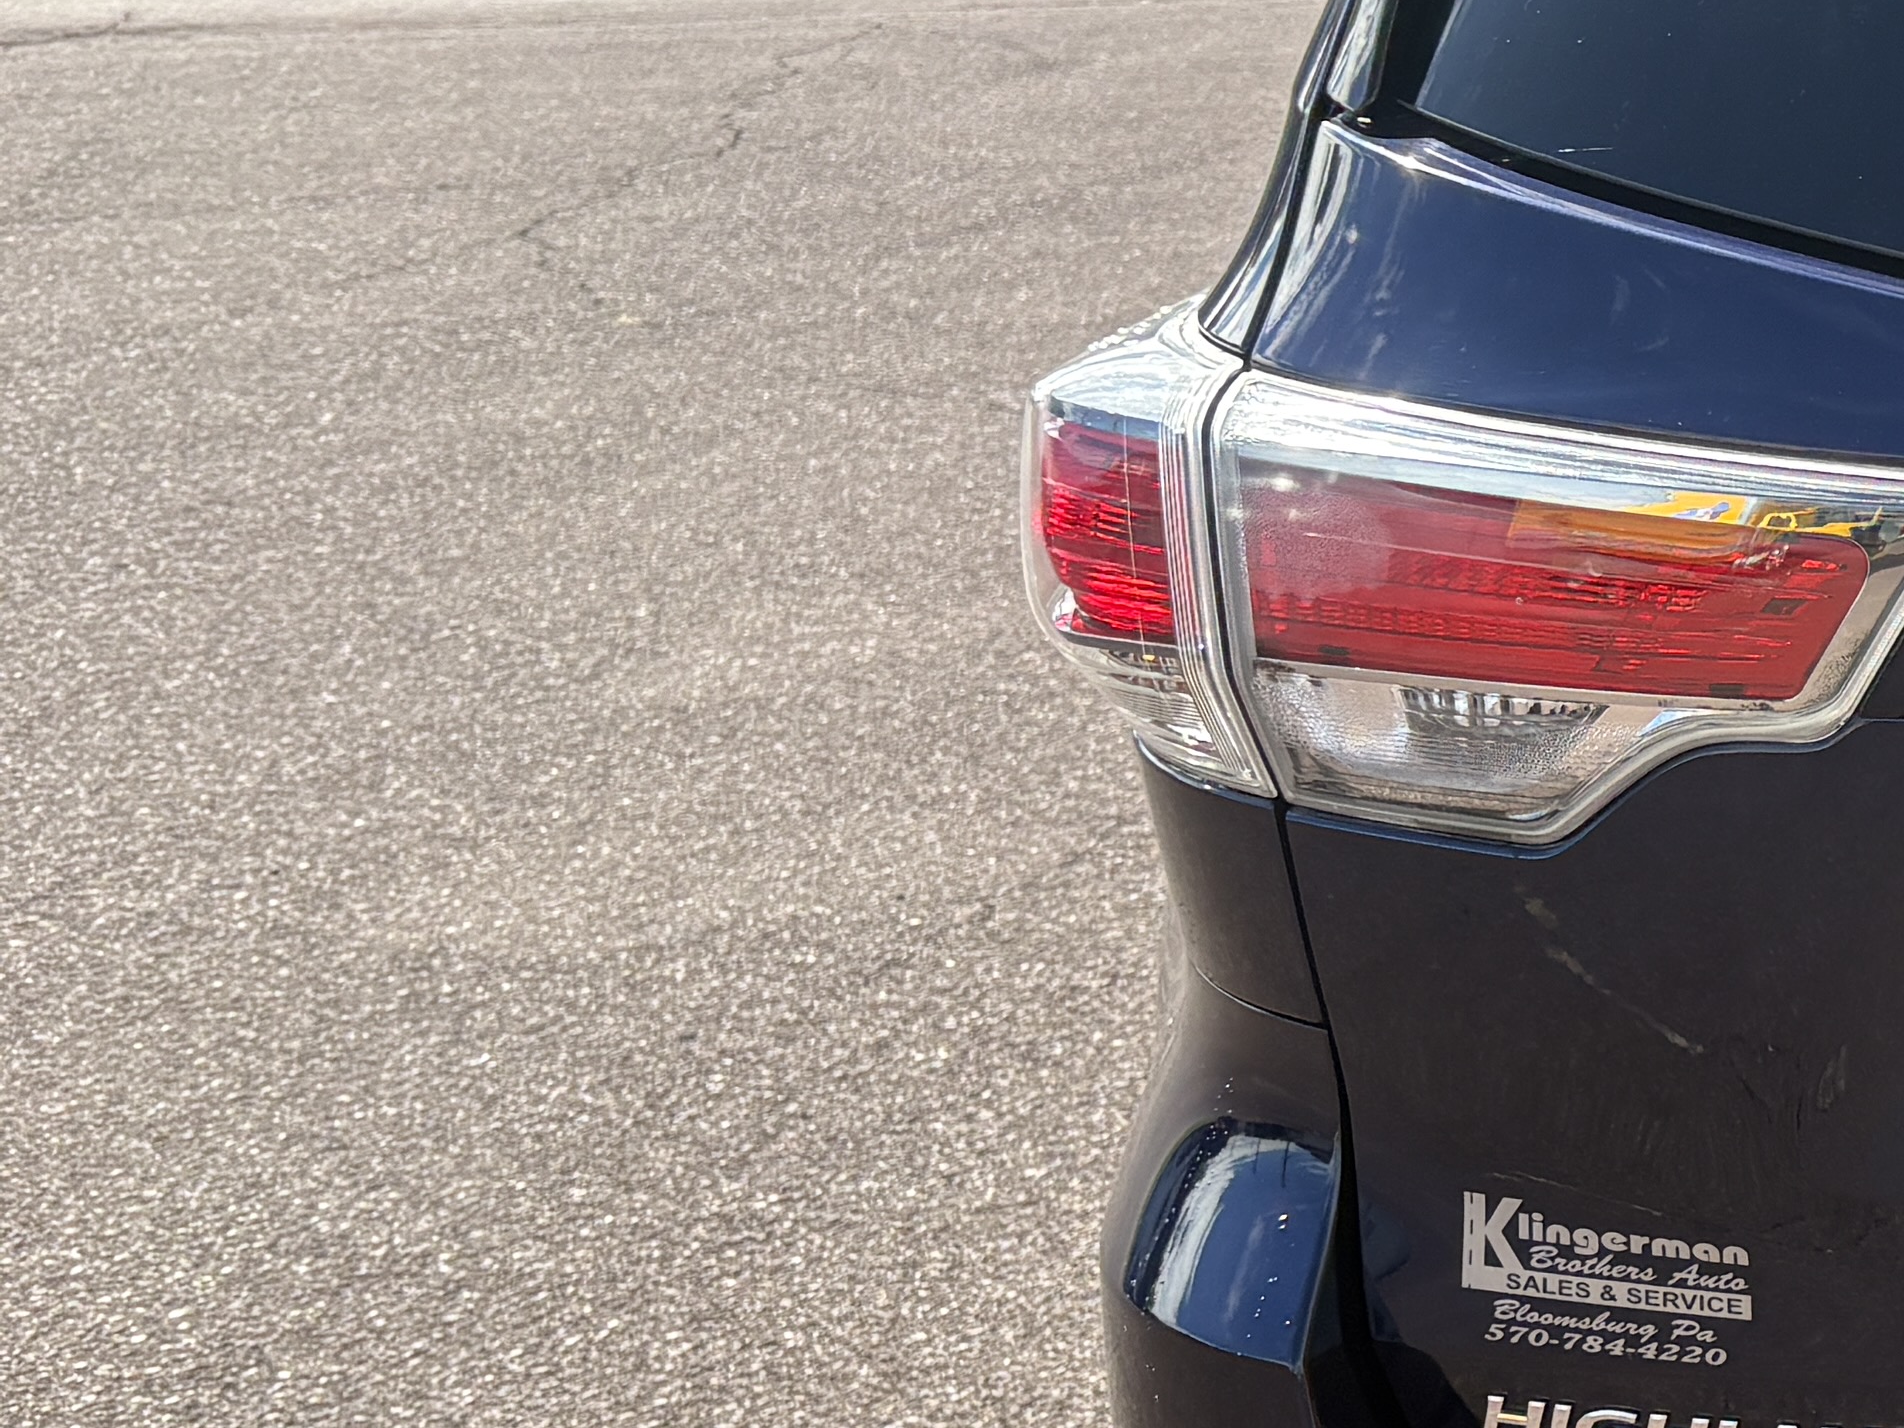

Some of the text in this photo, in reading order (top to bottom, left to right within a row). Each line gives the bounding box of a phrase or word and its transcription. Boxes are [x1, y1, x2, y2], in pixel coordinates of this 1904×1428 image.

[1462, 1190, 1751, 1284] Klingerman
[1528, 1244, 1750, 1292] Brothers Auto
[1505, 1271, 1744, 1316] SALES & SERVICE
[1492, 1298, 1718, 1344] Bloomsburg Pa
[1484, 1323, 1728, 1366] 570-784-4220
